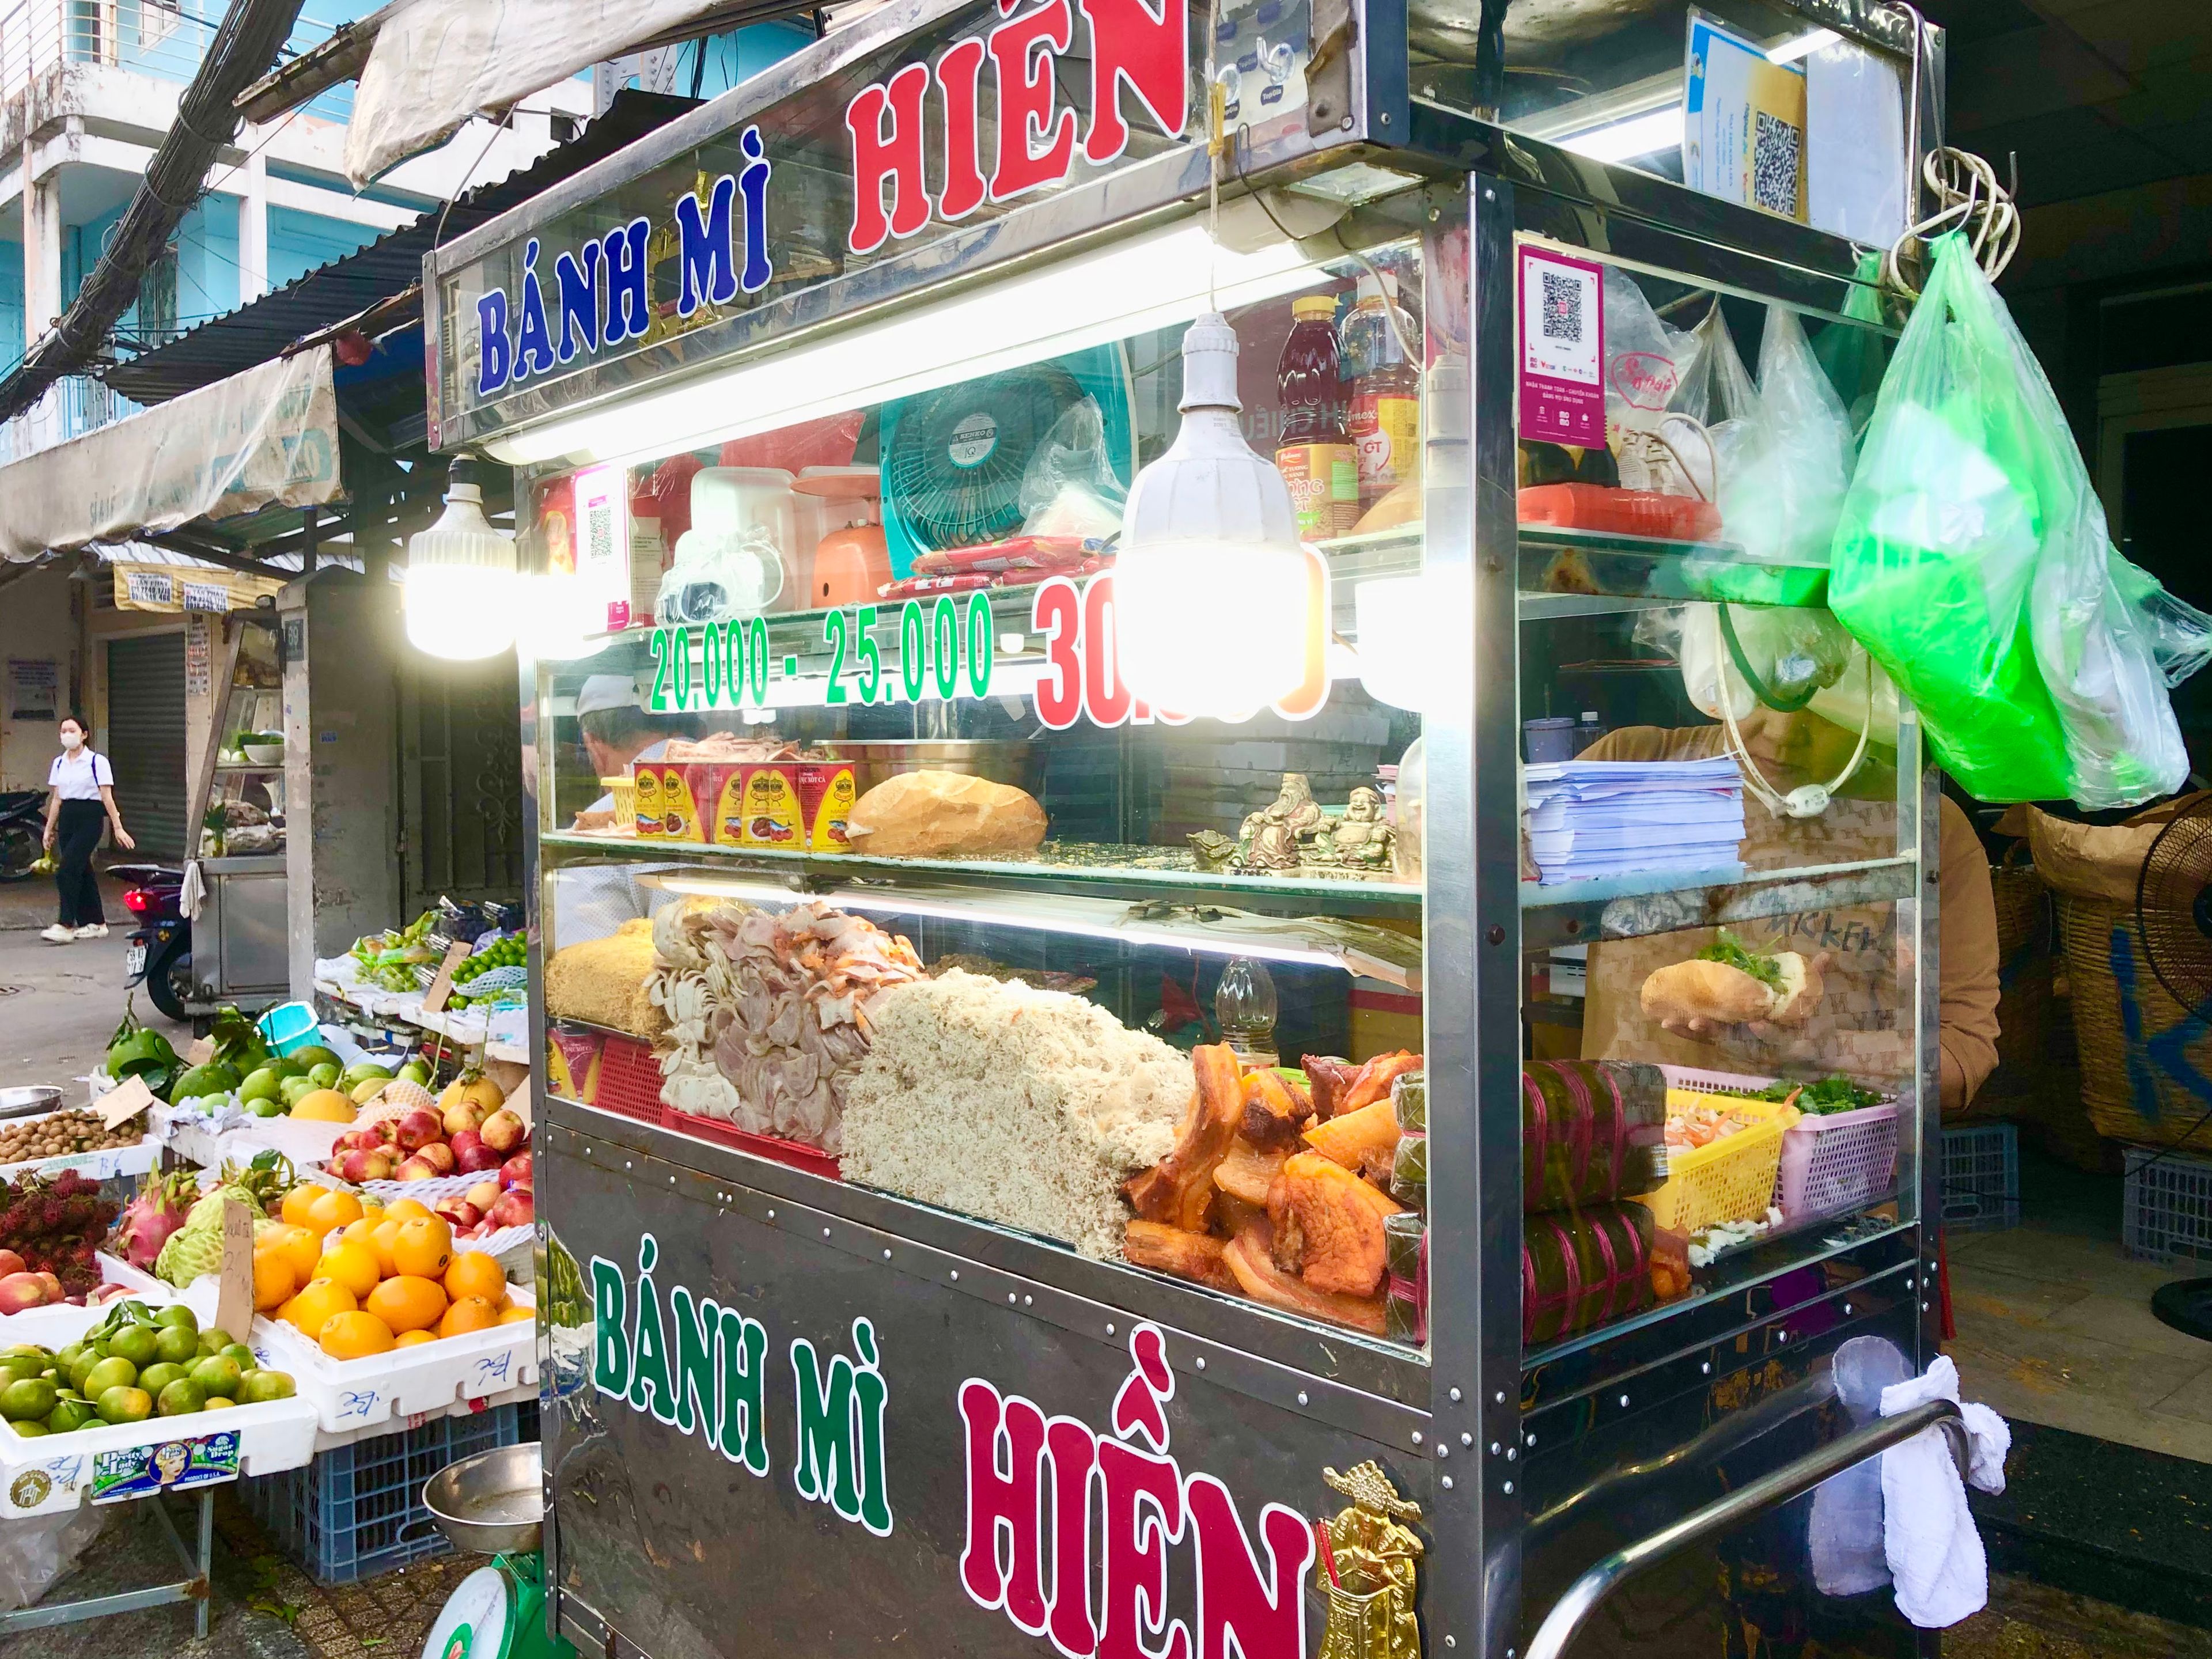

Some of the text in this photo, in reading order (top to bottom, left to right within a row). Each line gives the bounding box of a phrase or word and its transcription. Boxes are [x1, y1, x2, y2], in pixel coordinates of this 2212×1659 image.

[477, 124, 772, 397] BÁNH MÌ
[649, 615, 770, 713] 20.000
[823, 589, 994, 707] 25.000
[590, 1233, 893, 1537] BÁNH MÌ
[207, 1444, 234, 1453] Sugar
[210, 1450, 234, 1459] Drop
[102, 1451, 141, 1468] Pretty
[109, 1459, 138, 1476] Lady
[184, 1474, 203, 1483] PRODUCT
[958, 1322, 1316, 1659] HIỀN
